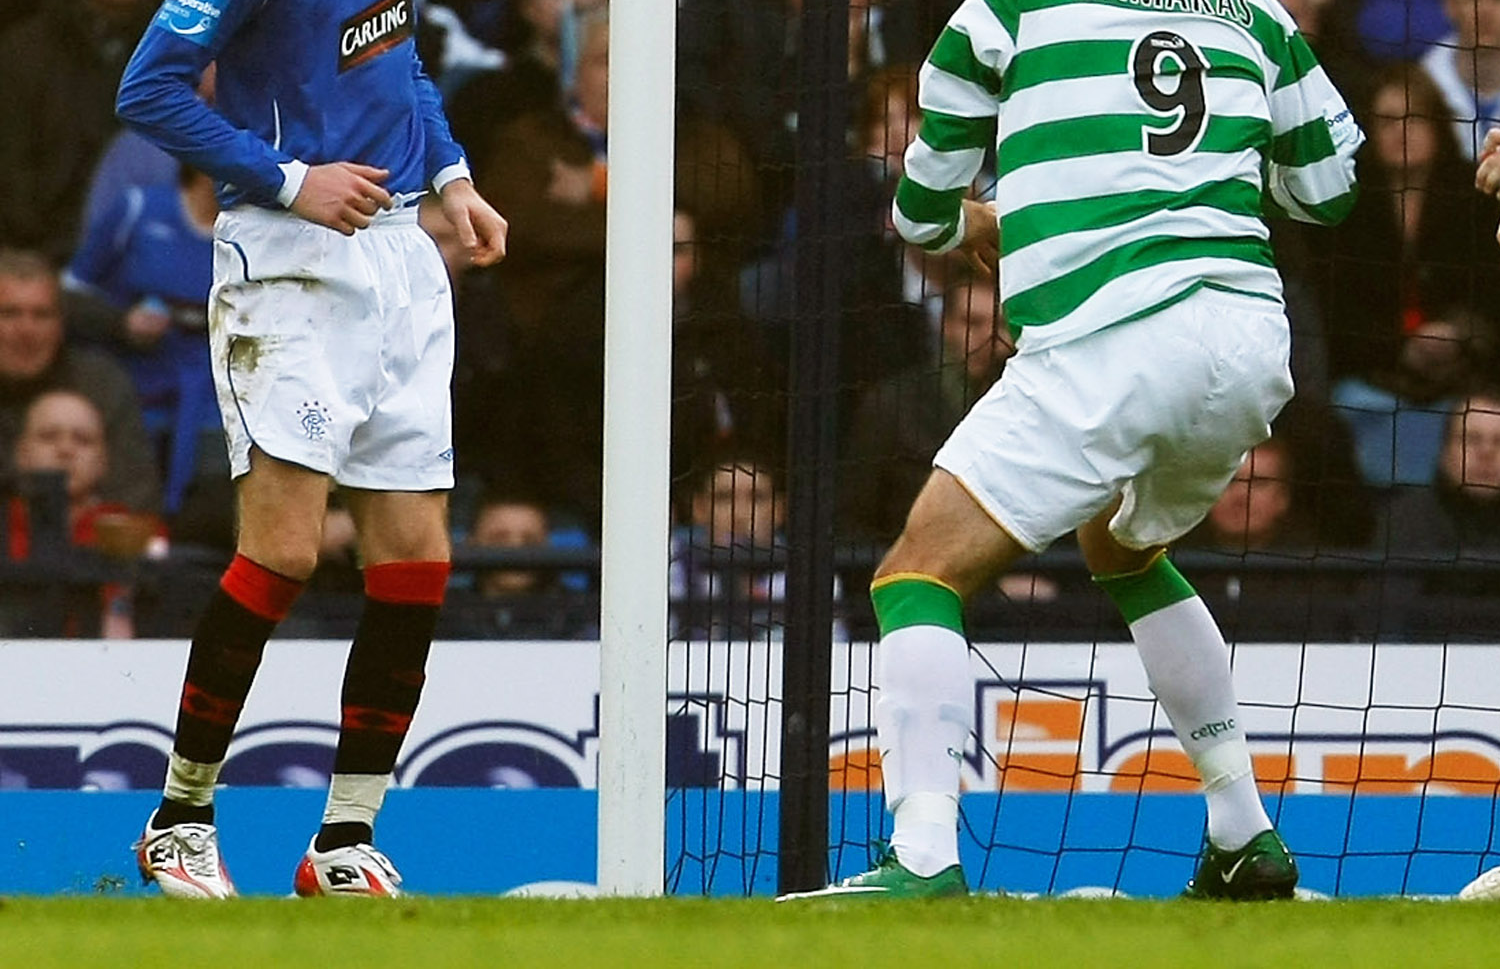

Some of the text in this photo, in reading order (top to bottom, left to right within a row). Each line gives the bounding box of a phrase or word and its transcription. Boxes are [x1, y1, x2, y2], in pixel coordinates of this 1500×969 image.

[341, 0, 407, 56] CARLING
[1127, 30, 1211, 157] 9
[1190, 718, 1235, 741] celtic
